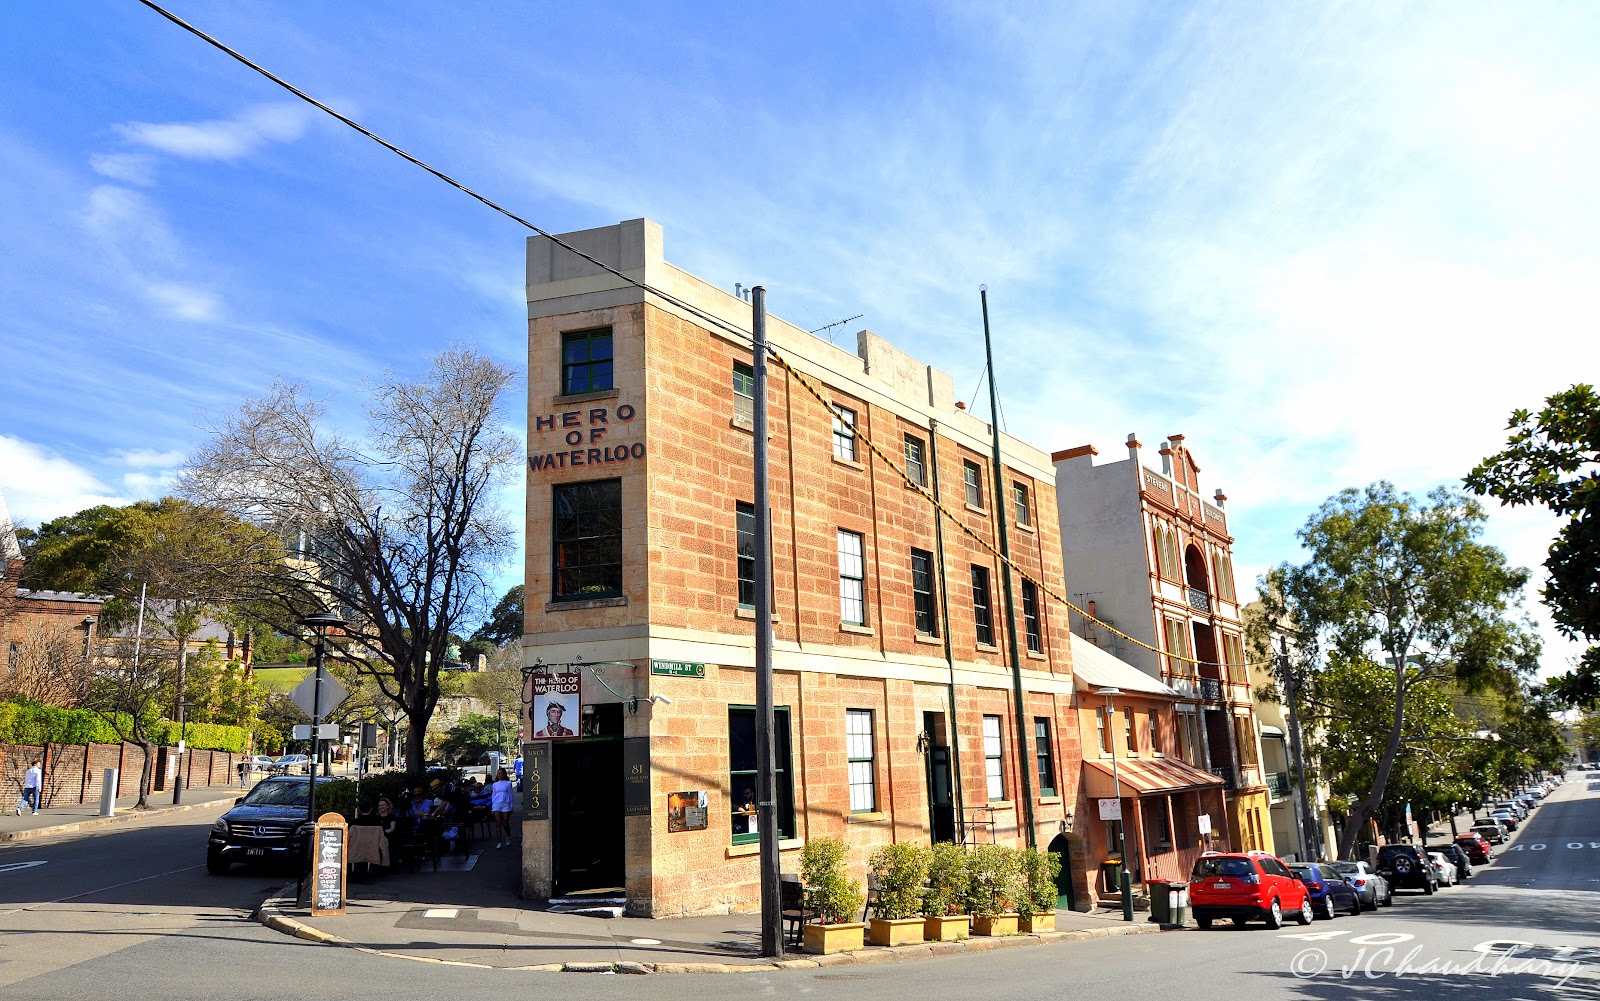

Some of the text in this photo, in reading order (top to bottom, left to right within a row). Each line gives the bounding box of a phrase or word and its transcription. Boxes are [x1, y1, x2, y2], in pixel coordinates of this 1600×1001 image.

[536, 404, 636, 432] HERO
[565, 428, 608, 447] OF
[528, 442, 646, 472] WATERLOO
[653, 661, 692, 672] WINDMILL ST
[534, 676, 579, 685] THE HERO OF
[534, 684, 578, 693] WATERLOO
[631, 764, 643, 775] 81
[530, 757, 541, 809] 1843
[1508, 843, 1547, 851] 40
[1275, 930, 1415, 945] 40
